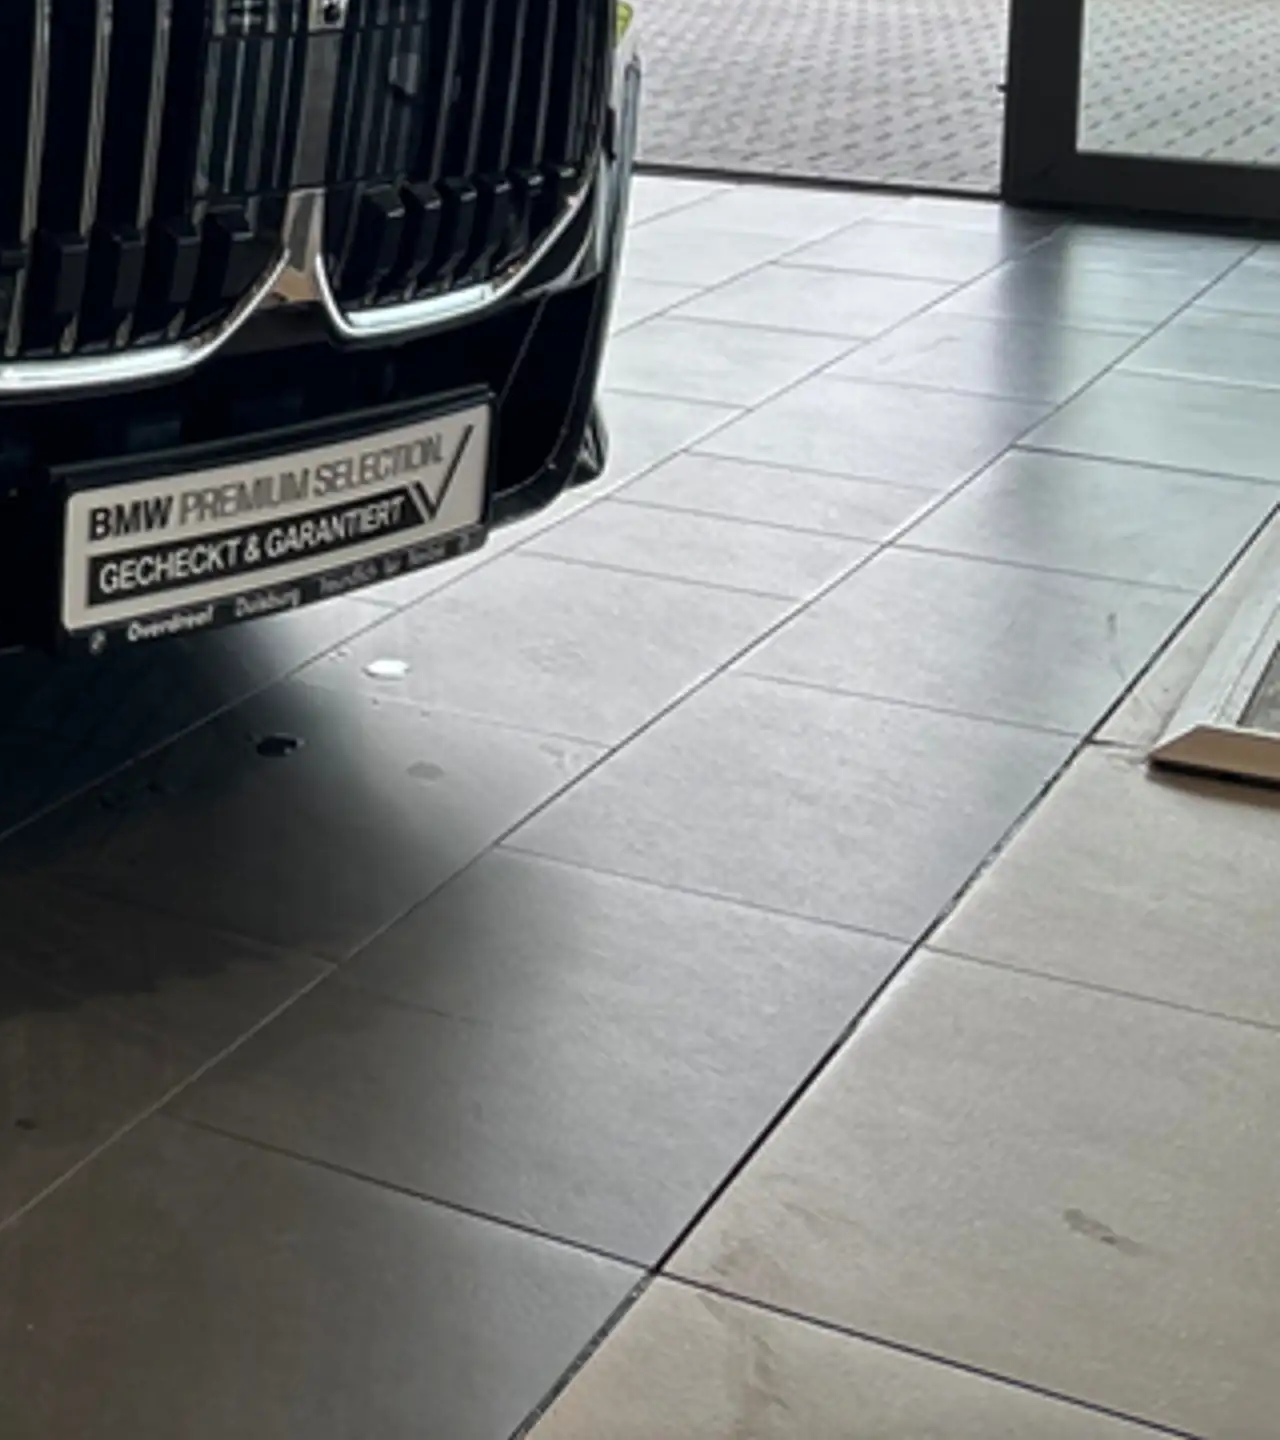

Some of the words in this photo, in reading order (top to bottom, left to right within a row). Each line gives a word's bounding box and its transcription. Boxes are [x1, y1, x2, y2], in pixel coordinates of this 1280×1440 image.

[88, 495, 173, 541] BMW
[178, 468, 310, 524] PREMIUM
[99, 538, 242, 594] GECHECKT
[244, 534, 261, 563] &
[265, 495, 406, 558] GARANTIERT
